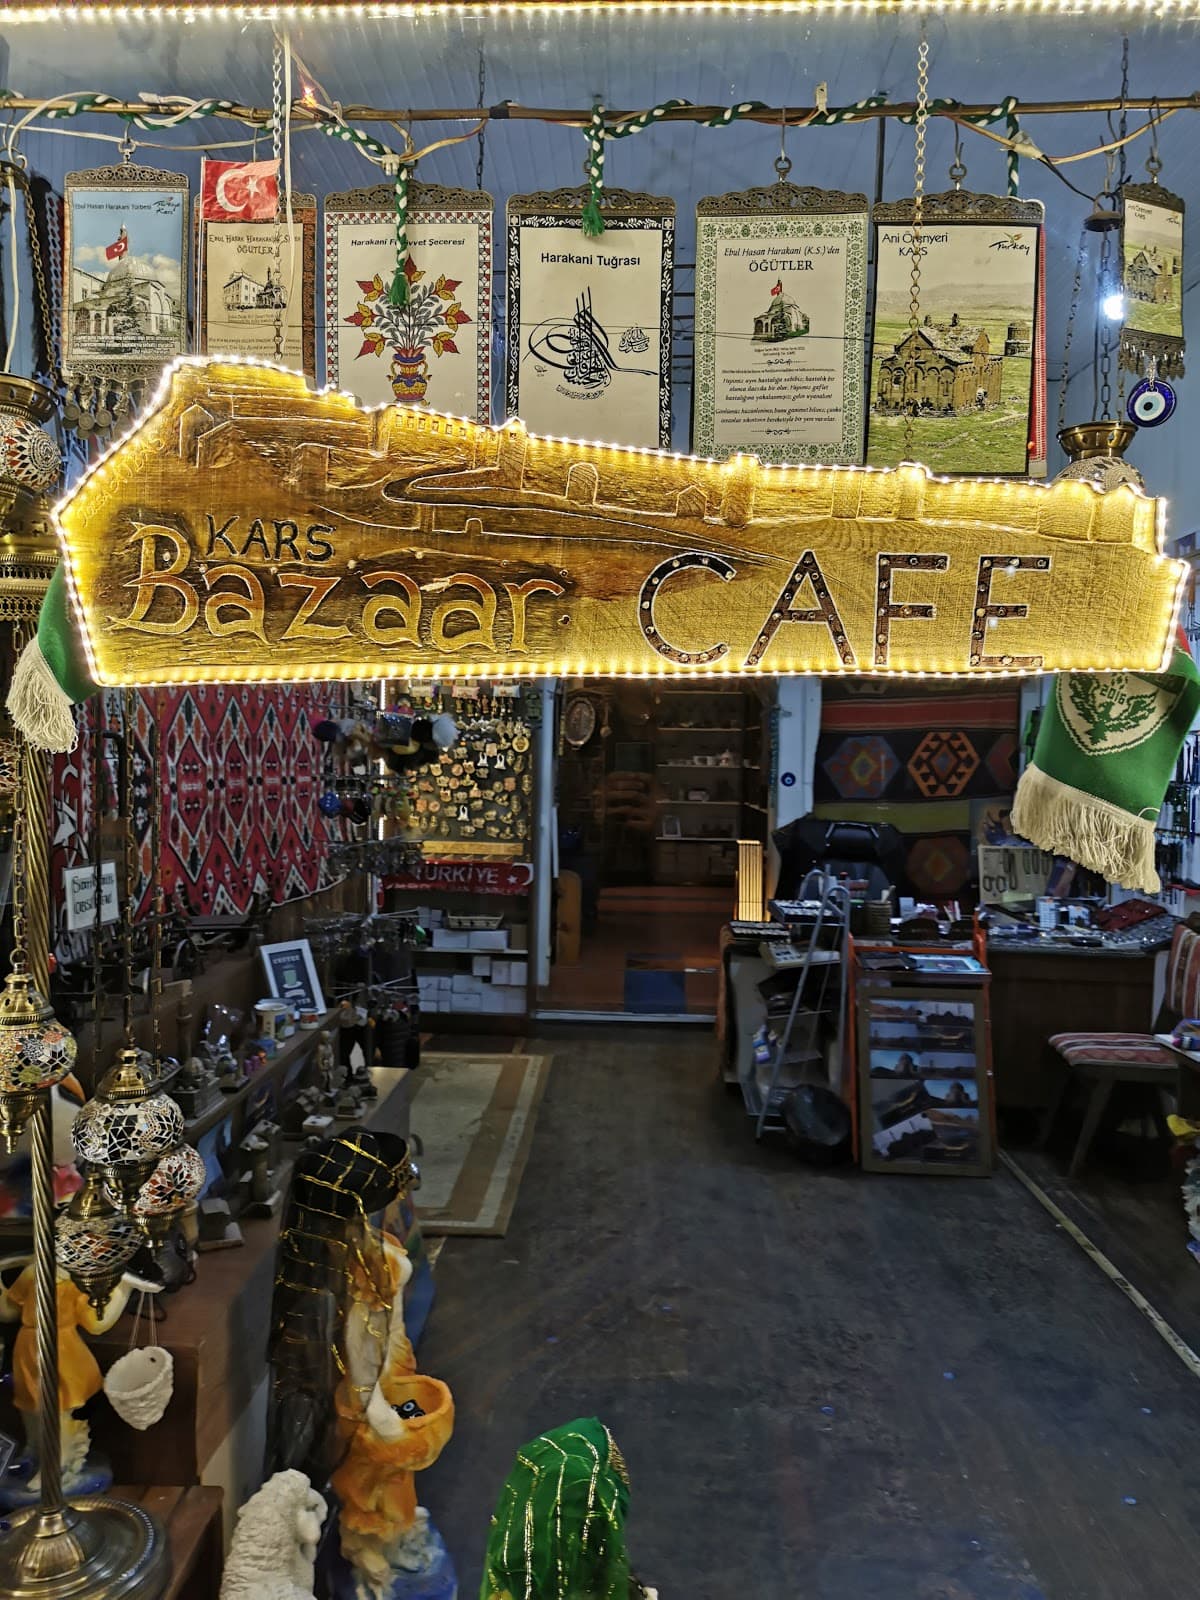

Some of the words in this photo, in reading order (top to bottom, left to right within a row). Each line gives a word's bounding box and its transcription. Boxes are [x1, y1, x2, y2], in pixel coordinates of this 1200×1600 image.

[882, 233, 900, 244] Ani
[724, 247, 741, 257] Ebul
[742, 247, 766, 257] Hasan
[767, 246, 802, 256] Harakani
[989, 240, 1030, 256] Turkey
[541, 252, 593, 265] Harakani
[596, 255, 641, 269] Tuğrası
[749, 258, 815, 273] ÖĞÜTLER
[206, 512, 337, 562] KARS
[104, 520, 566, 655] Bazaar
[637, 549, 1052, 667] CAFE
[1100, 686, 1127, 705] 2016
